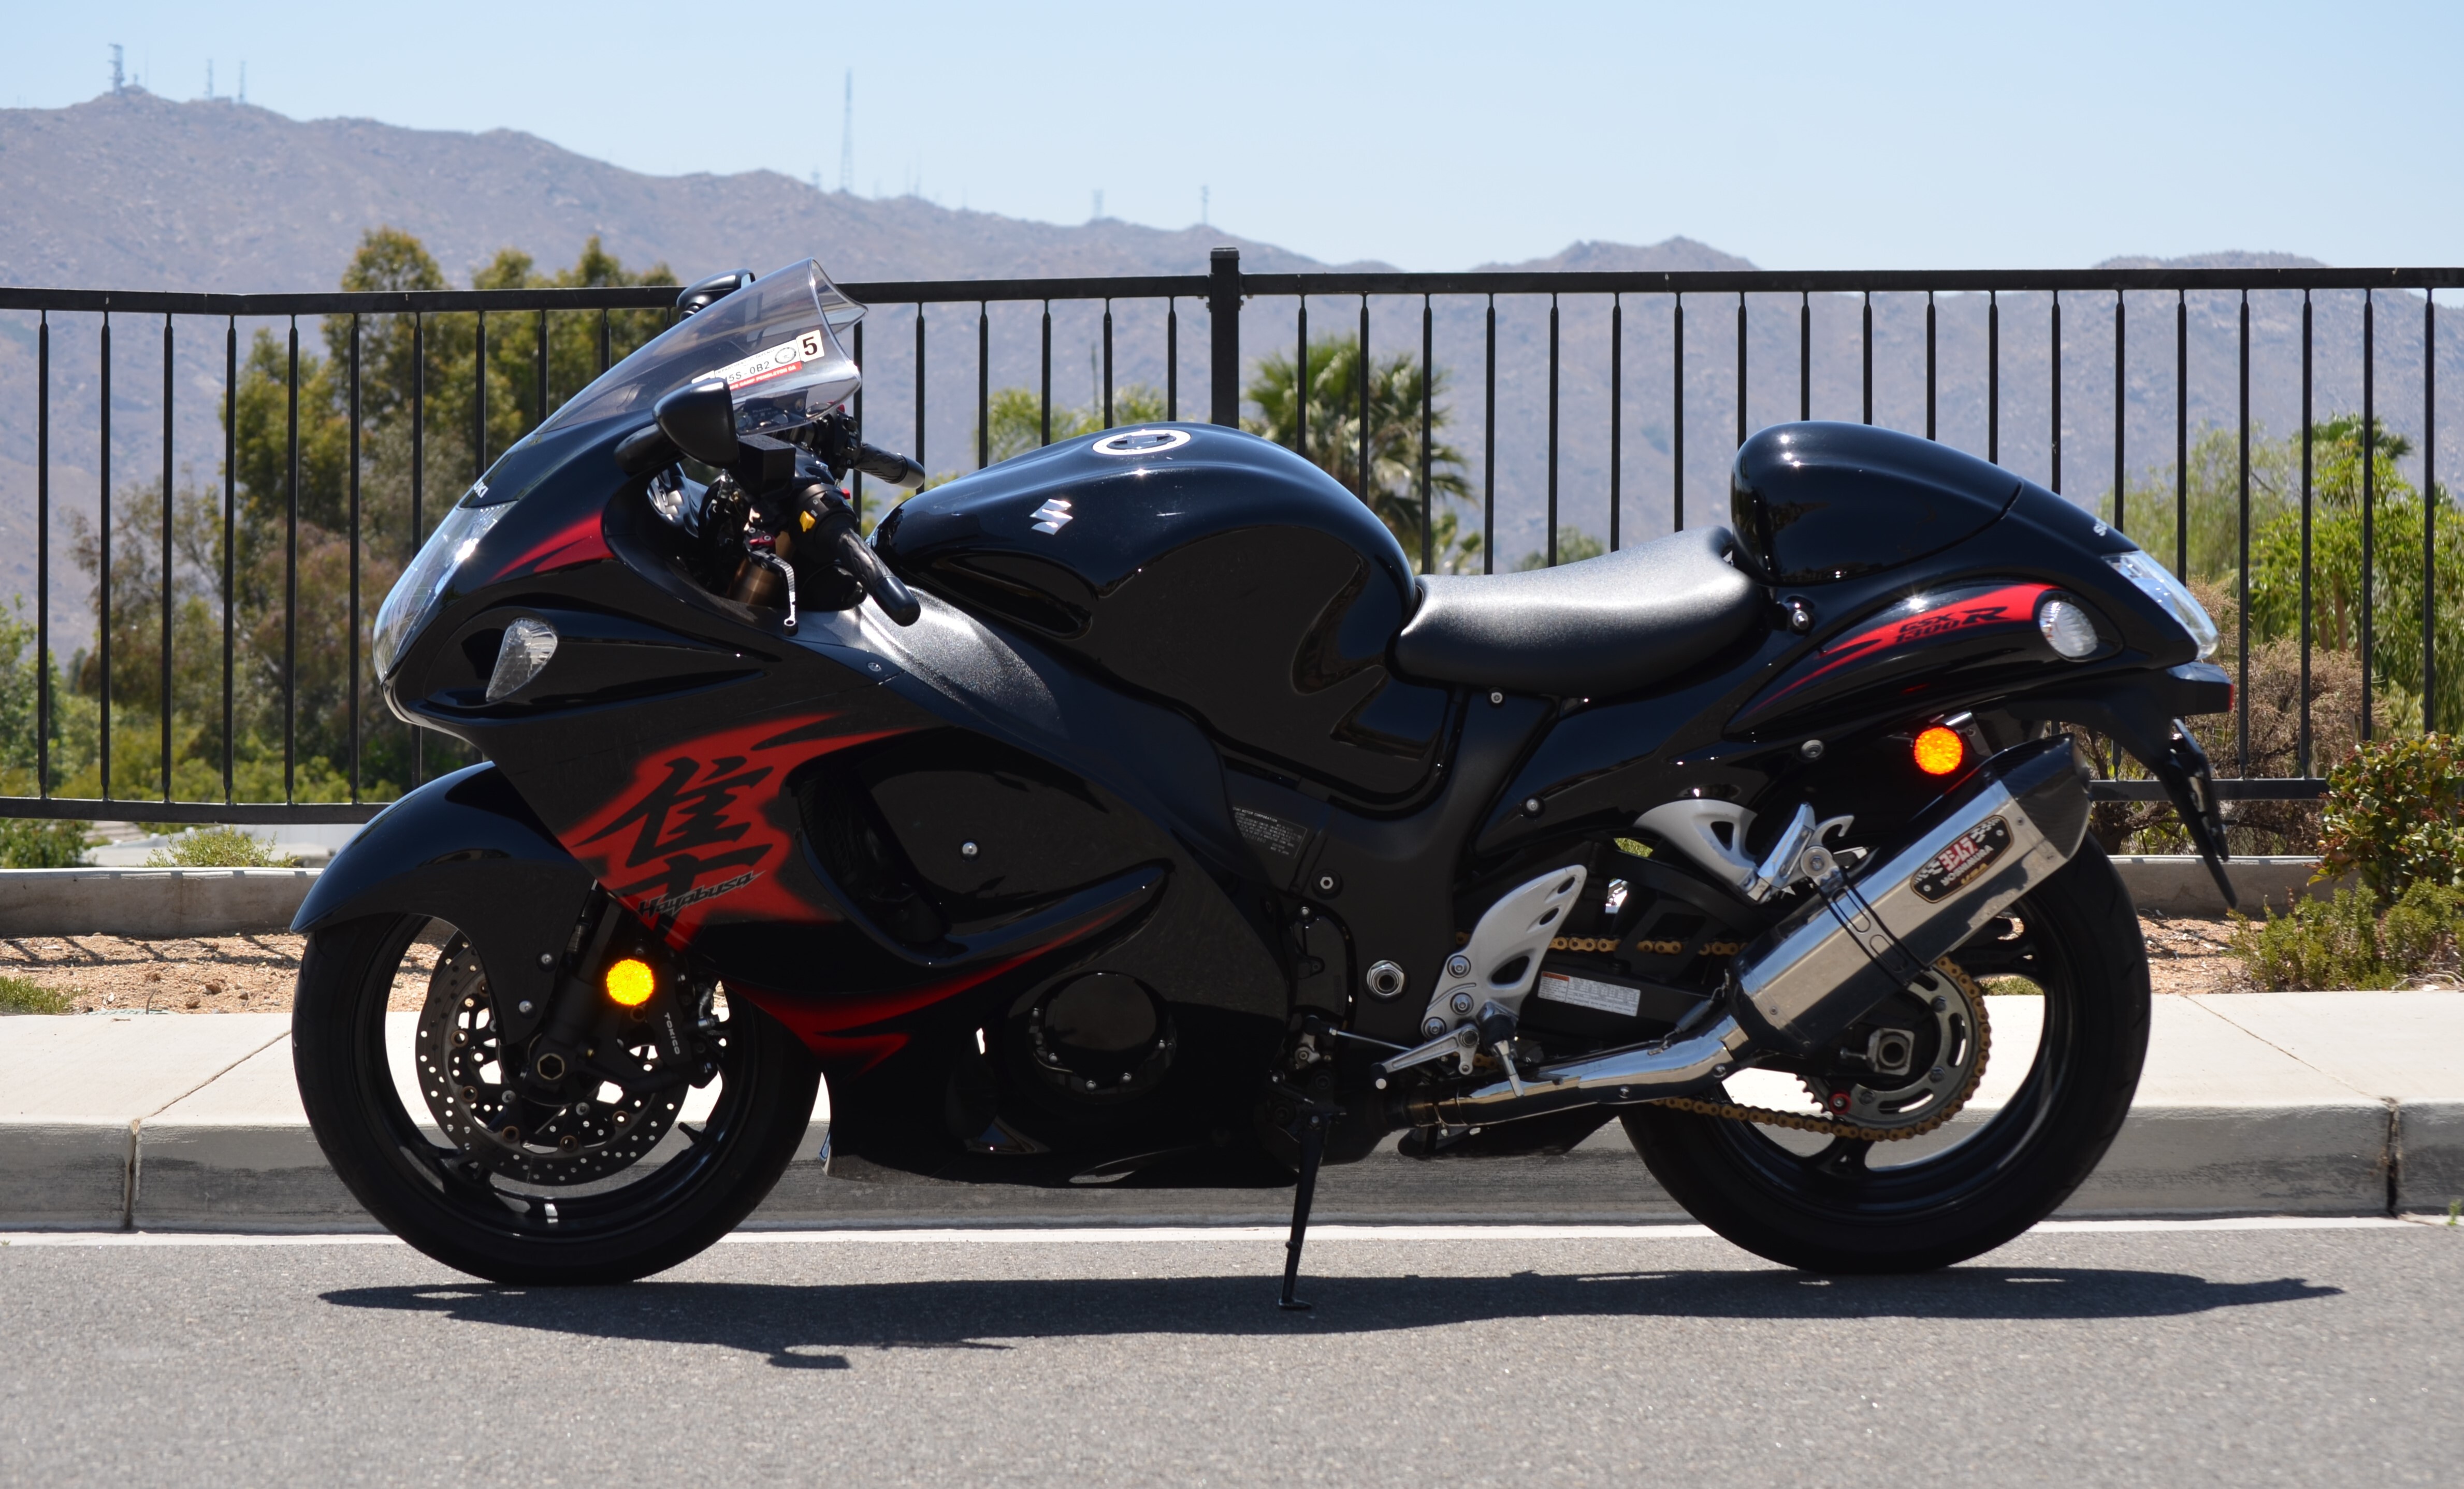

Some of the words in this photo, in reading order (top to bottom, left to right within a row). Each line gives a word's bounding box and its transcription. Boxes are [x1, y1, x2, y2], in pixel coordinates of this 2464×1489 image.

[802, 336, 818, 356] 5
[740, 378, 755, 386] CAMP
[1894, 620, 1961, 643] 1300
[1900, 612, 1957, 633] GSX
[1940, 845, 1994, 887] YOSHIMURA
[637, 870, 766, 919] Hayabusa
[664, 1011, 680, 1055] TOKICO
